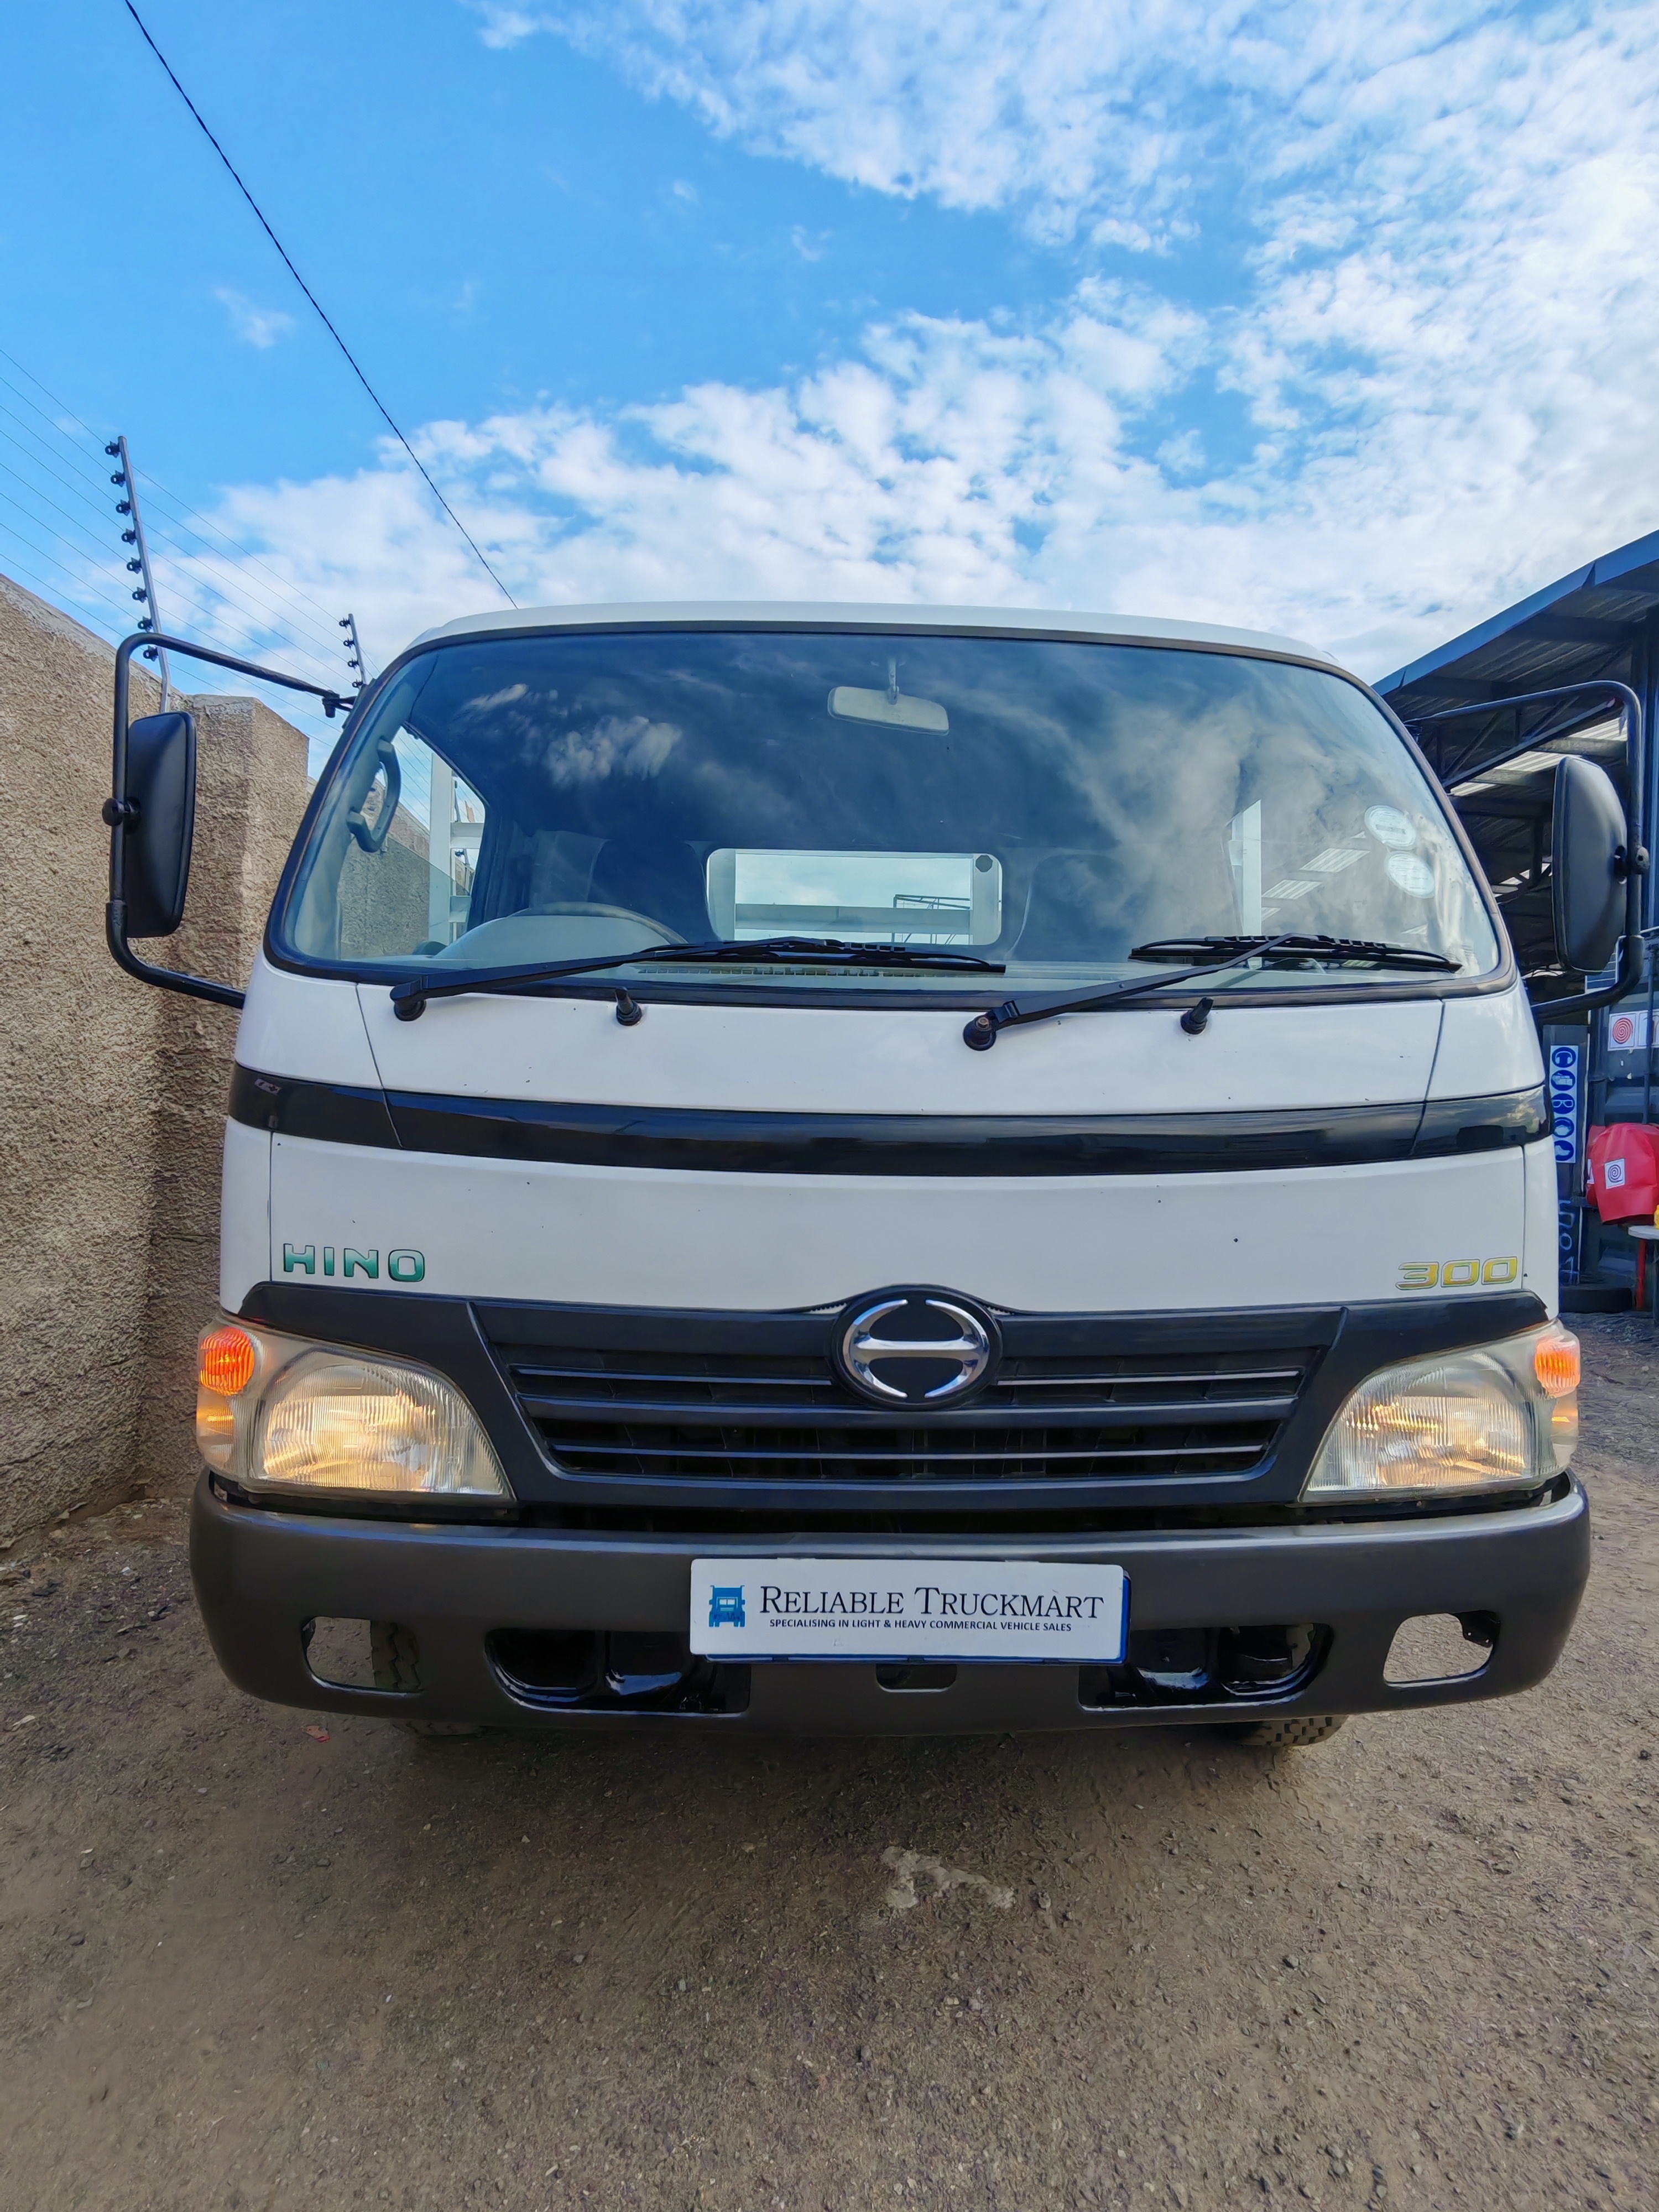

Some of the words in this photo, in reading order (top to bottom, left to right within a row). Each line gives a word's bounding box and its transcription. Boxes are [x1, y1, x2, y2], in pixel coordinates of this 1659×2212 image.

[283, 1243, 425, 1282] HINO
[1395, 1256, 1517, 1290] 300
[769, 1619, 836, 1627] SPECIALISING
[838, 1619, 849, 1627] IN
[852, 1619, 881, 1628] LIGHT
[884, 1619, 891, 1628] &
[895, 1620, 927, 1629] HEAVY
[930, 1620, 998, 1630] COMMERCIAL
[1000, 1622, 1040, 1631] VEHICLE
[1043, 1623, 1072, 1631] SALES
